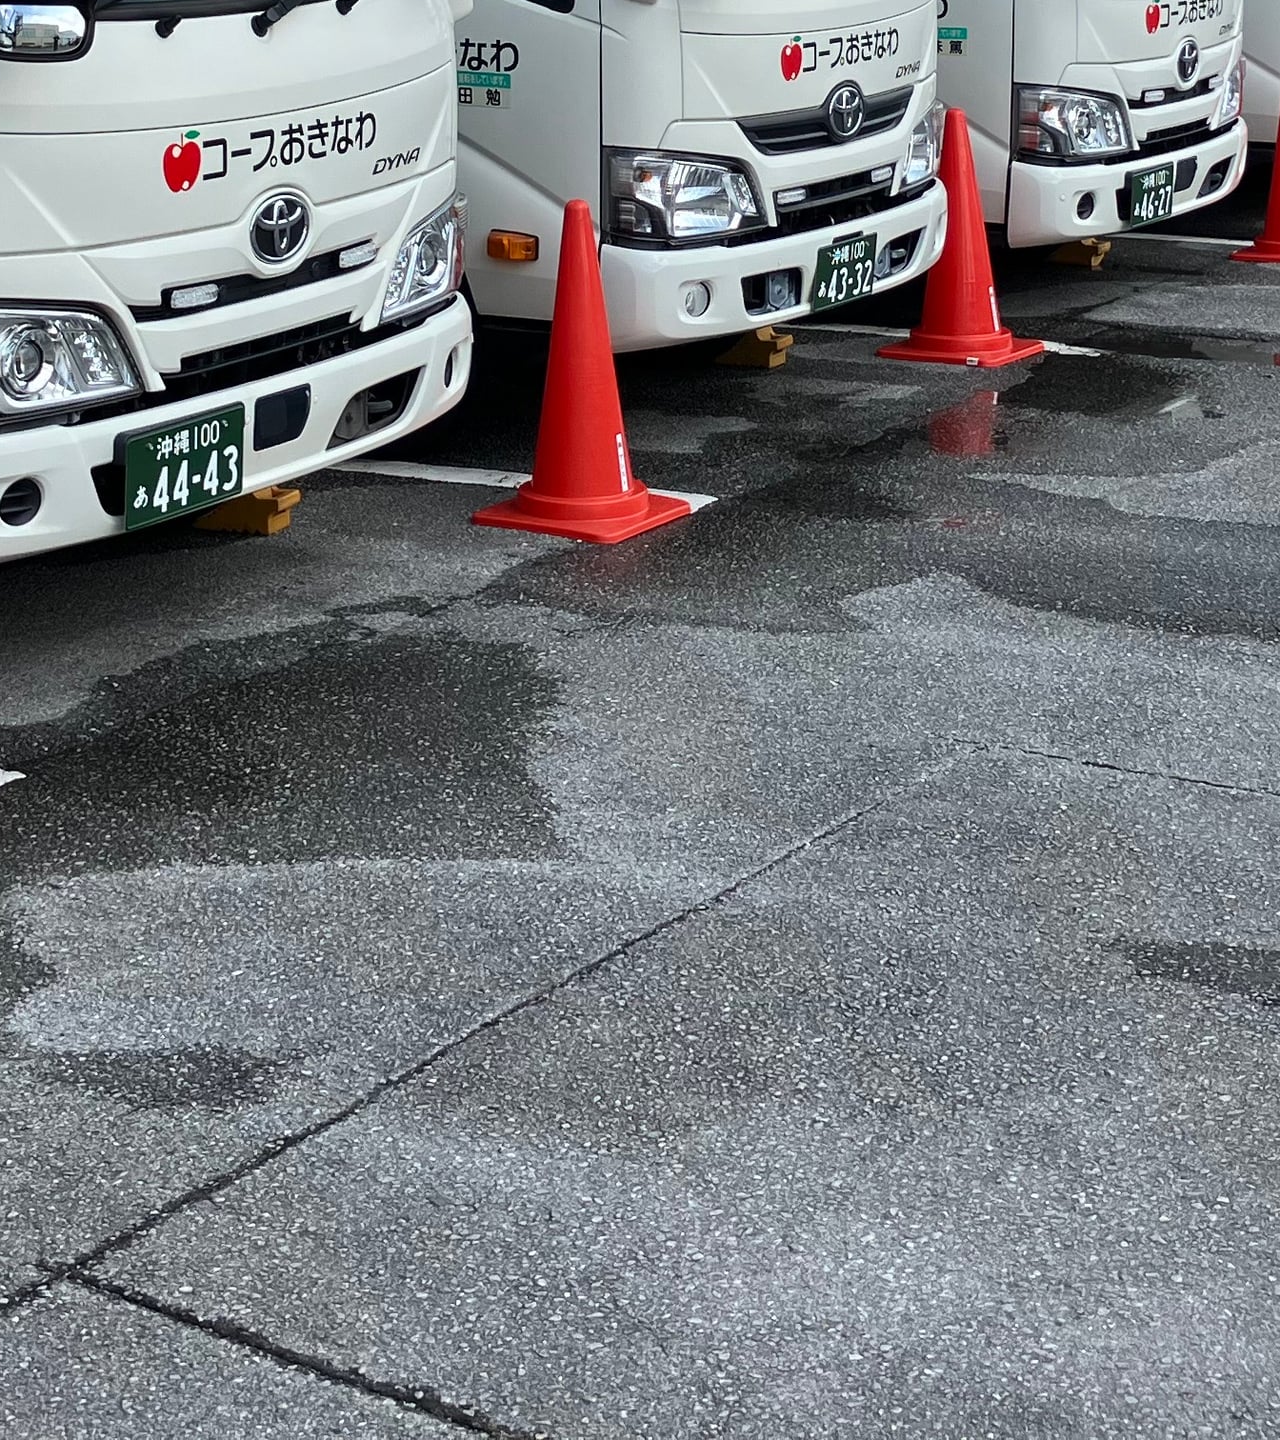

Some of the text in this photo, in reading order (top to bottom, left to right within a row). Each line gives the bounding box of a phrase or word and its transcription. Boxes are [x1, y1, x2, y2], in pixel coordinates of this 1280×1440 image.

[455, 37, 519, 72] なわ
[372, 146, 421, 175] DYNA
[1141, 185, 1172, 221] 46-27
[827, 260, 873, 303] 43-32
[152, 445, 239, 513] 44-43
